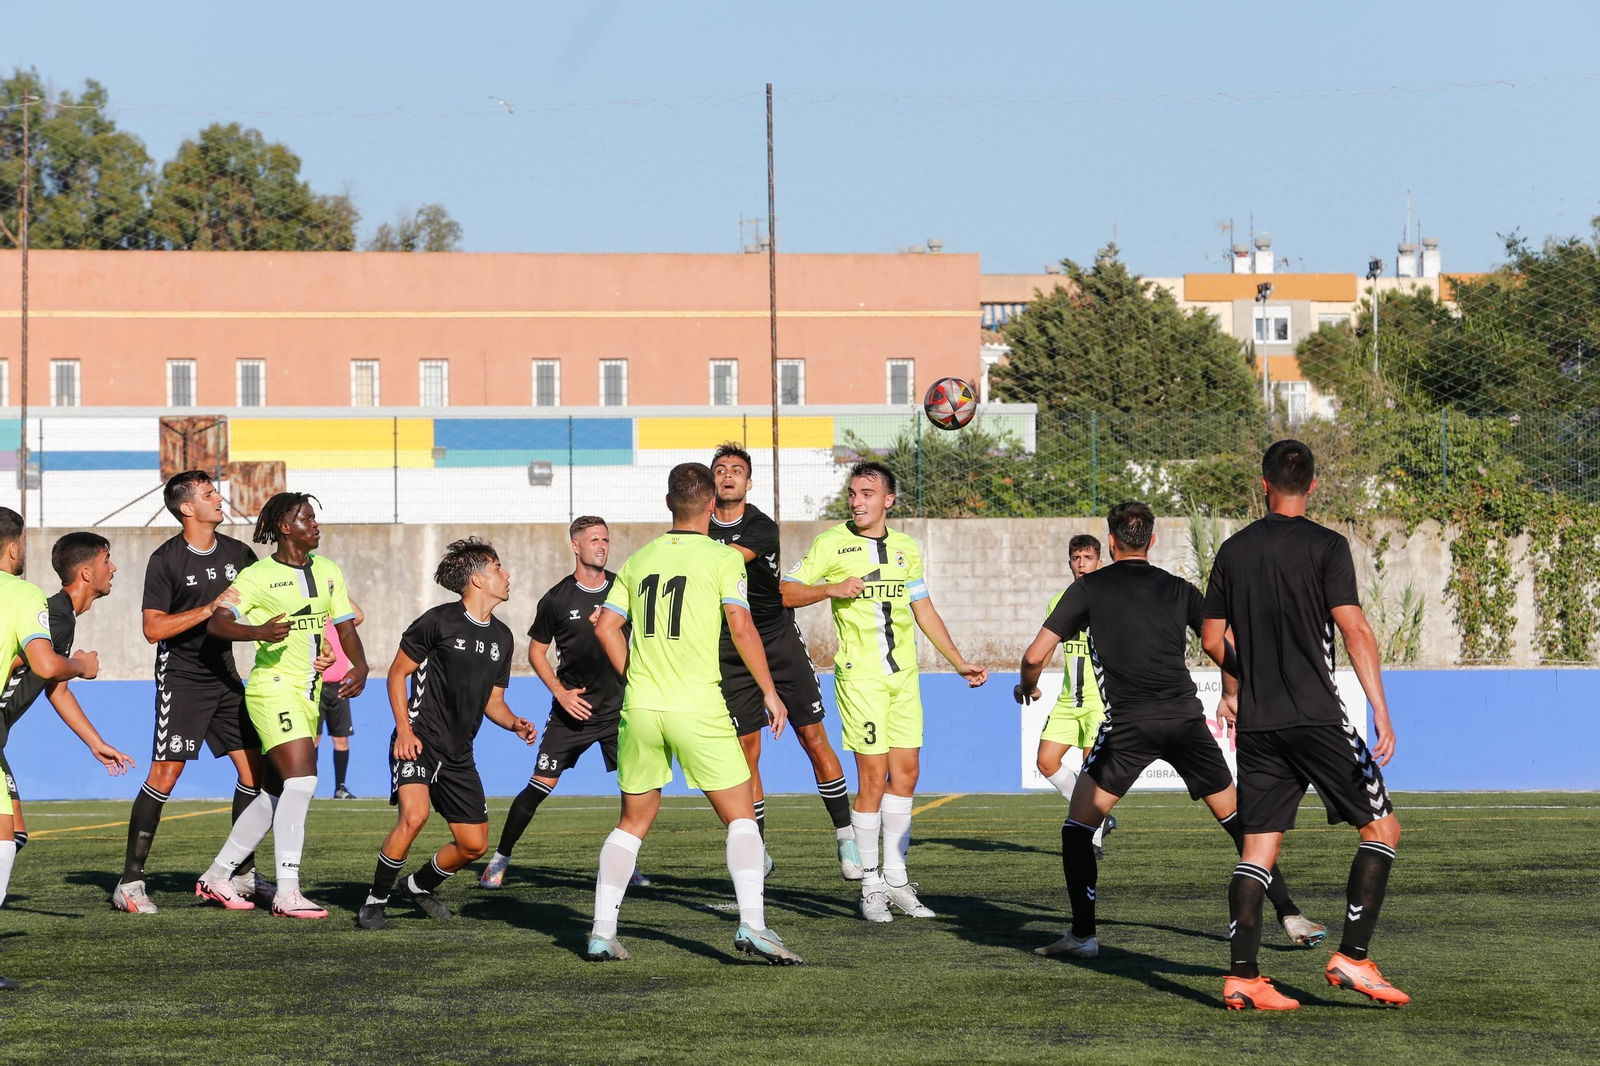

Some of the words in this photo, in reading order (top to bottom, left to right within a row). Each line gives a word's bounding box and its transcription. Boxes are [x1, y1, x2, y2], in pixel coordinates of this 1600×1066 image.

[838, 546, 863, 555] LEGEA
[205, 567, 217, 580] 15
[269, 580, 294, 589] LEGEA
[854, 584, 905, 600] OTUS
[638, 573, 687, 640] 11
[475, 640, 485, 654] 19
[277, 711, 293, 733] 5
[863, 721, 877, 745] 3
[184, 740, 195, 751] 15
[550, 759, 558, 770] 3
[416, 765, 426, 778] 19
